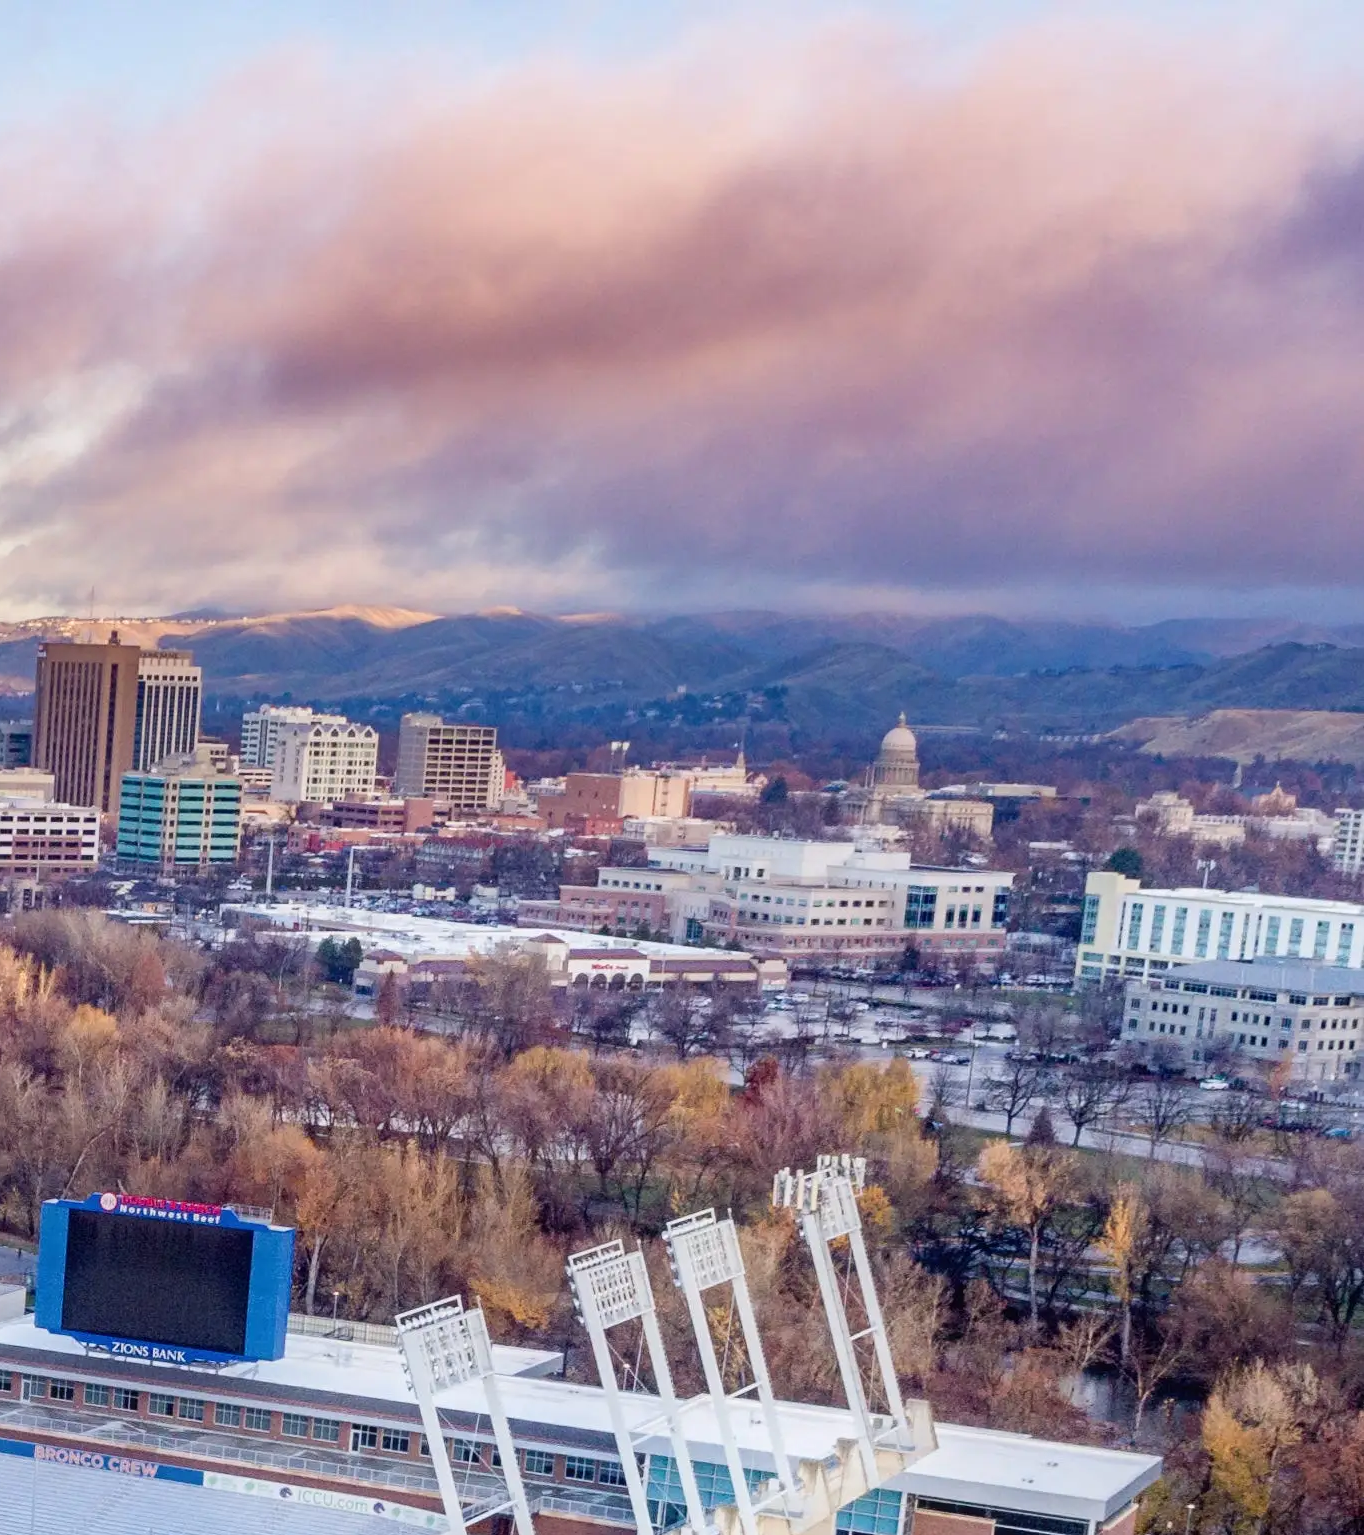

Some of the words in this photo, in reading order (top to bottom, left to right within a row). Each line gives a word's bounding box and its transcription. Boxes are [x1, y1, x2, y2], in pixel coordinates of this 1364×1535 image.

[120, 1204, 188, 1221] Northwest
[192, 1213, 221, 1225] Beef
[111, 1341, 149, 1357] ZIONS
[152, 1347, 186, 1362] BANK
[35, 1444, 103, 1470] BRONCO
[108, 1457, 159, 1479] CREW
[298, 1489, 368, 1513] ICCU.com
